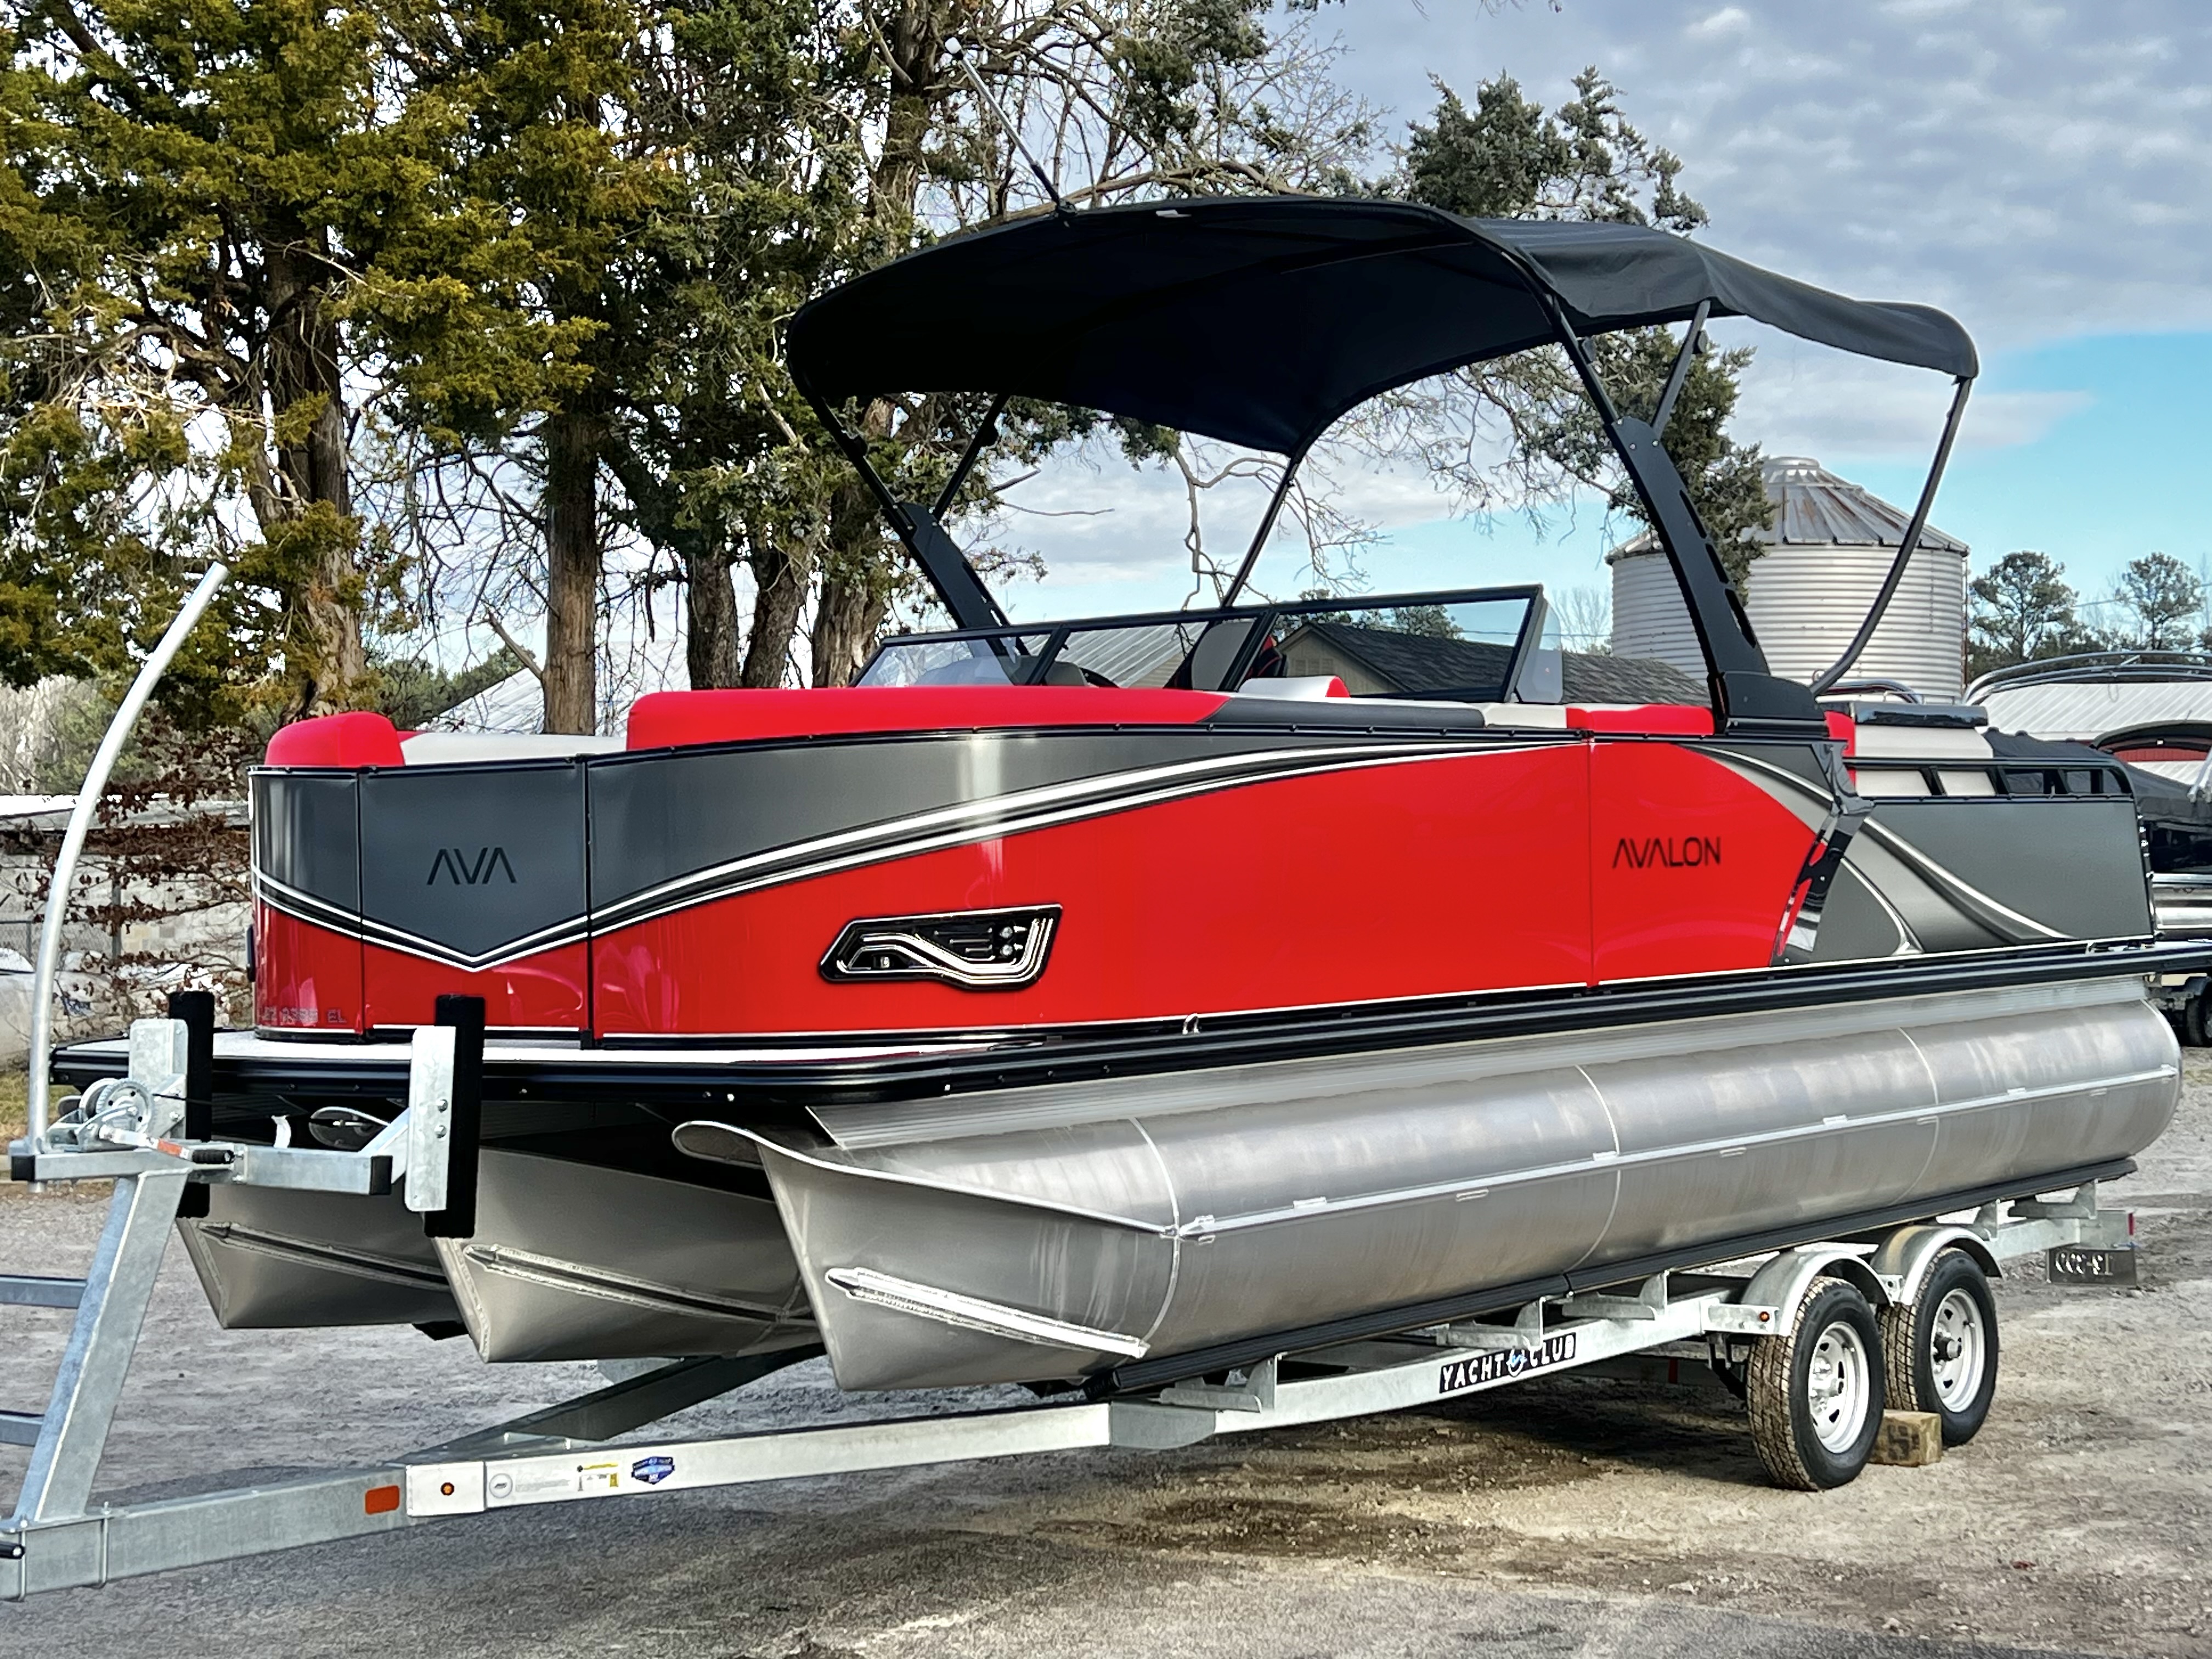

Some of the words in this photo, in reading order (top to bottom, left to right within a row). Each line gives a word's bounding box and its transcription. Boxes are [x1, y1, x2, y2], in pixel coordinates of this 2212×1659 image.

[426, 847, 517, 885] AVA
[1612, 836, 1721, 869] AVALON
[1442, 1353, 1504, 1391] YACHT
[1530, 1334, 1575, 1367] CLUB
